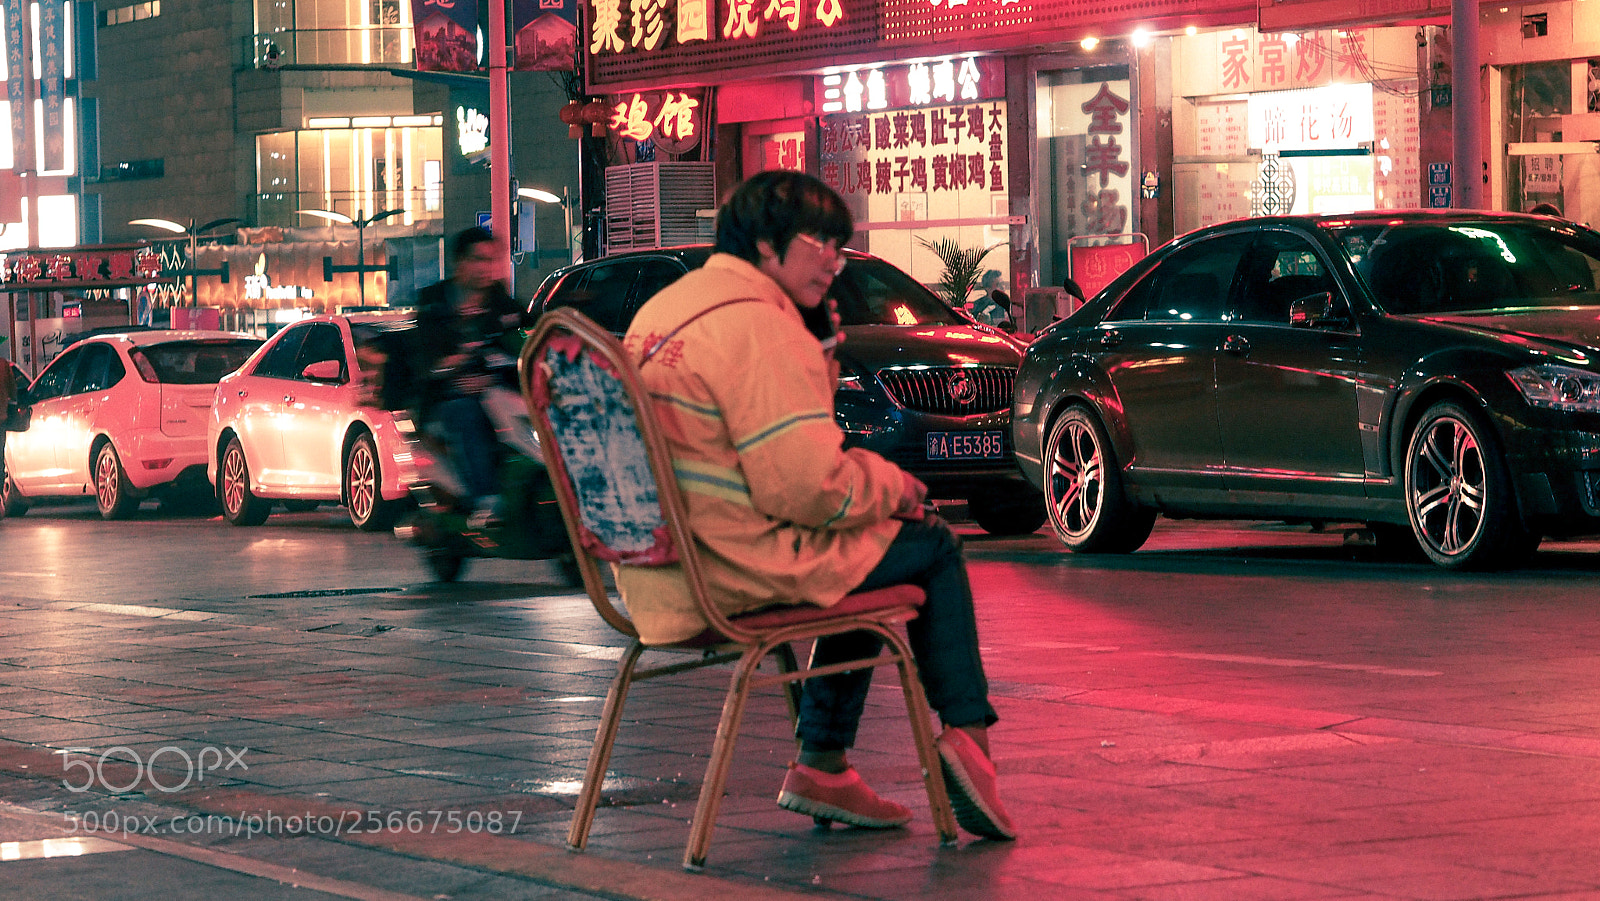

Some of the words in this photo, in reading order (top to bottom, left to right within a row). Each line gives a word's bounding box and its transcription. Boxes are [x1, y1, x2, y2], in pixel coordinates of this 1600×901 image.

[1221, 27, 1368, 89] 家常炒菜
[610, 92, 699, 141] 鸡馆
[1080, 82, 1130, 248] 全羊汤
